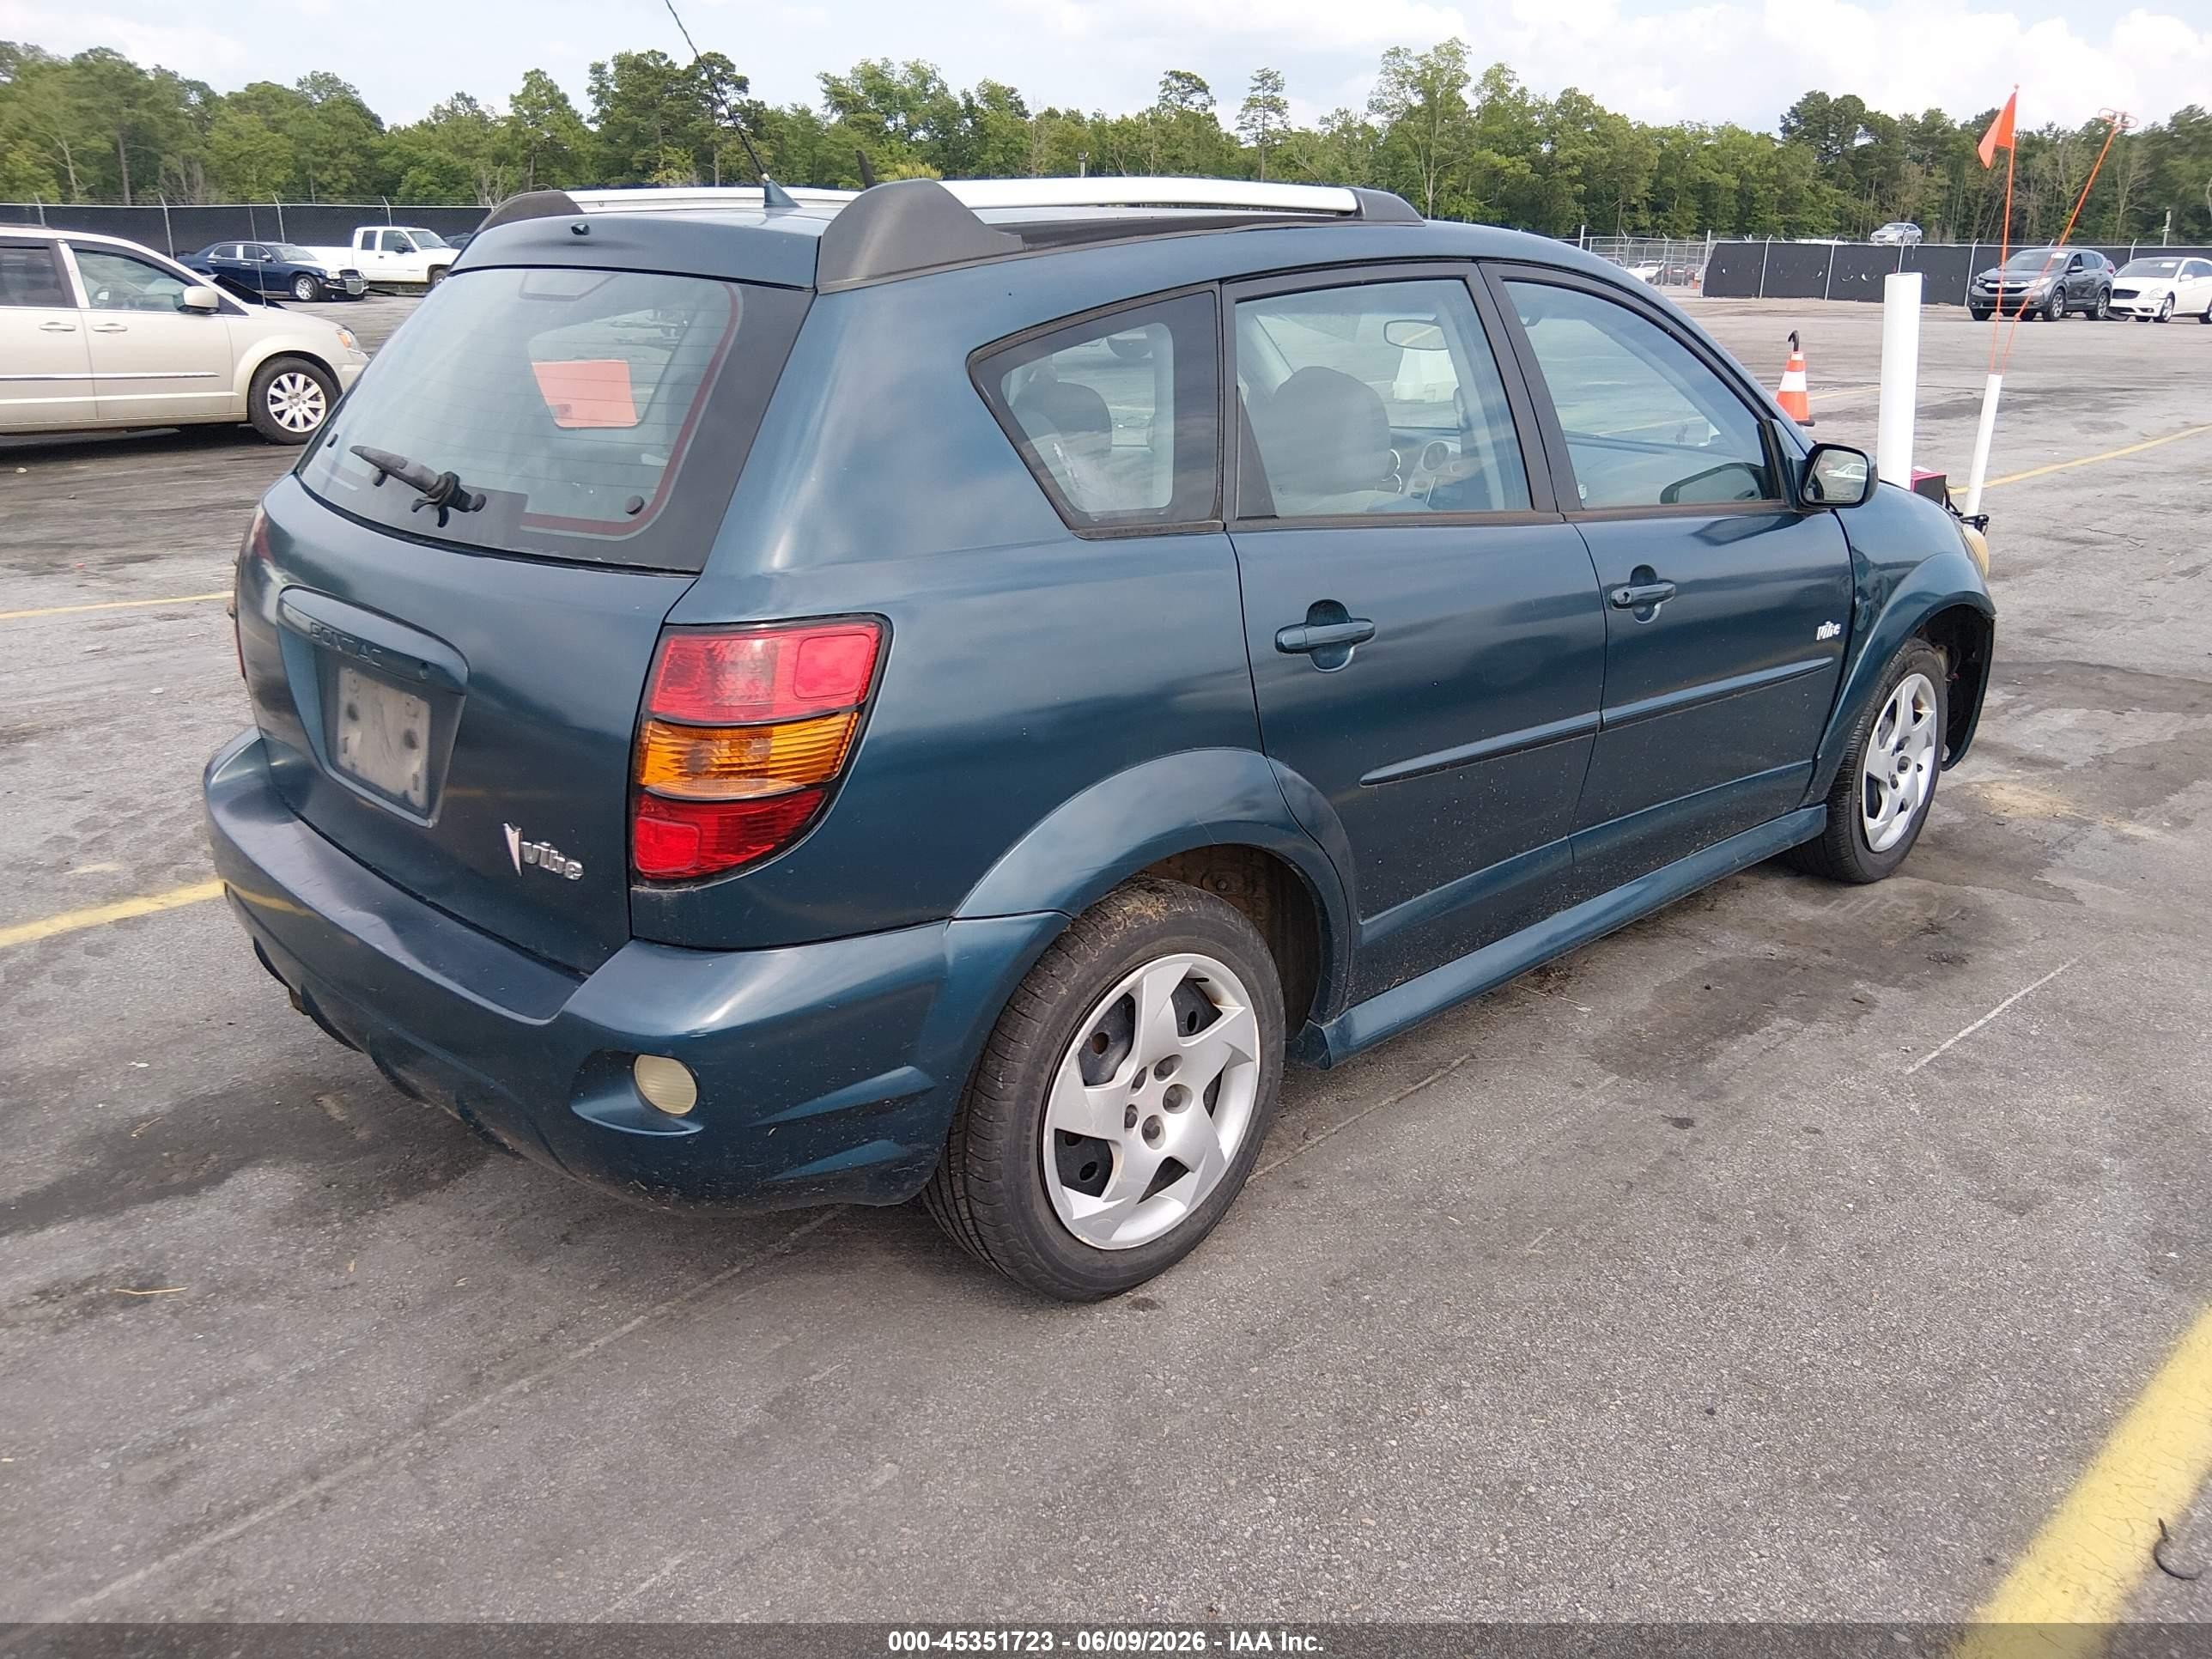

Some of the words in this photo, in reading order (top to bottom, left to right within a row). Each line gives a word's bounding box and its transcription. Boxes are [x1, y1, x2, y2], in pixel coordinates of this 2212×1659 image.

[310, 621, 385, 667] PONTAC
[1815, 620, 1842, 641] vibe
[520, 841, 584, 881] vibe
